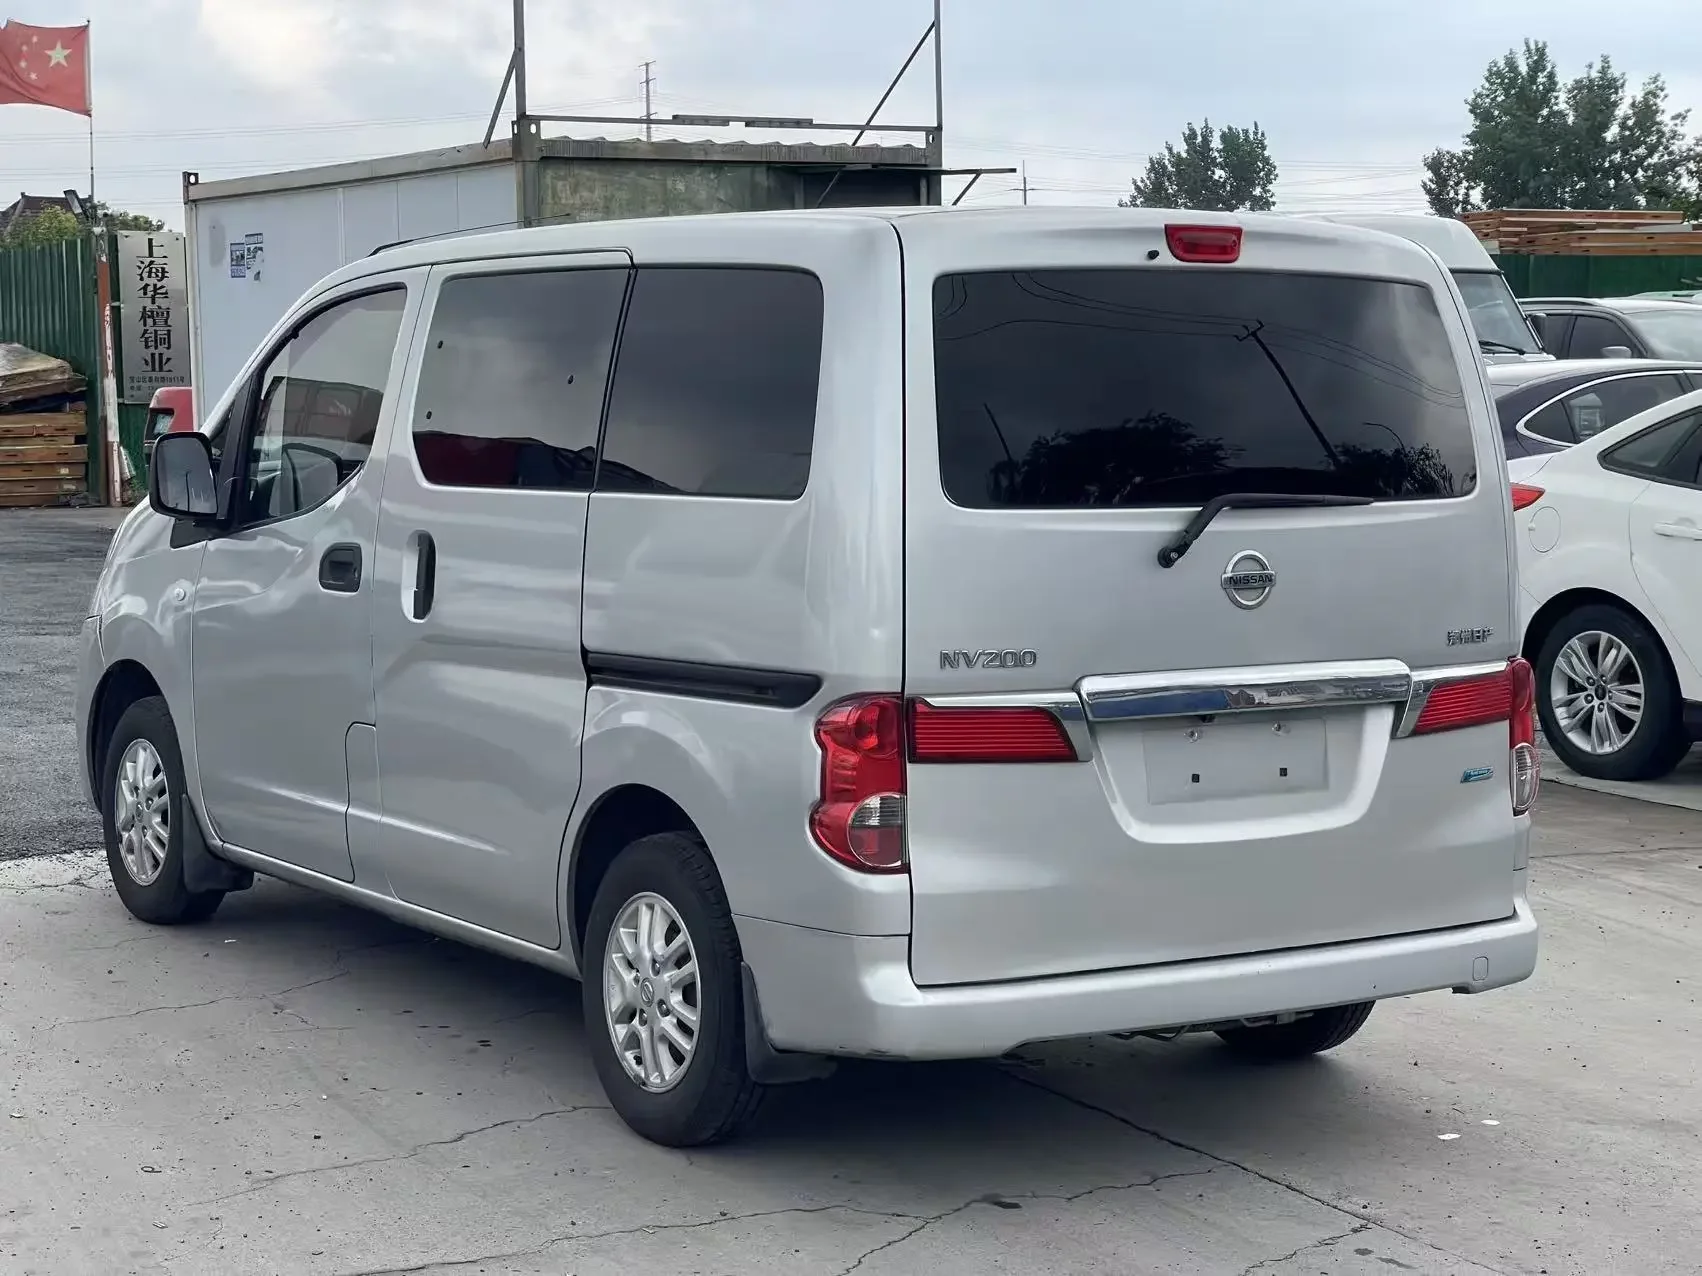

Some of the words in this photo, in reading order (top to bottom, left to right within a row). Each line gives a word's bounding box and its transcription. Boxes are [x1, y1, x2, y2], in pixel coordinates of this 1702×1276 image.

[136, 238, 173, 372] 上海华檀铜业
[1229, 574, 1273, 585] NISSAN
[940, 649, 1037, 669] NV200
